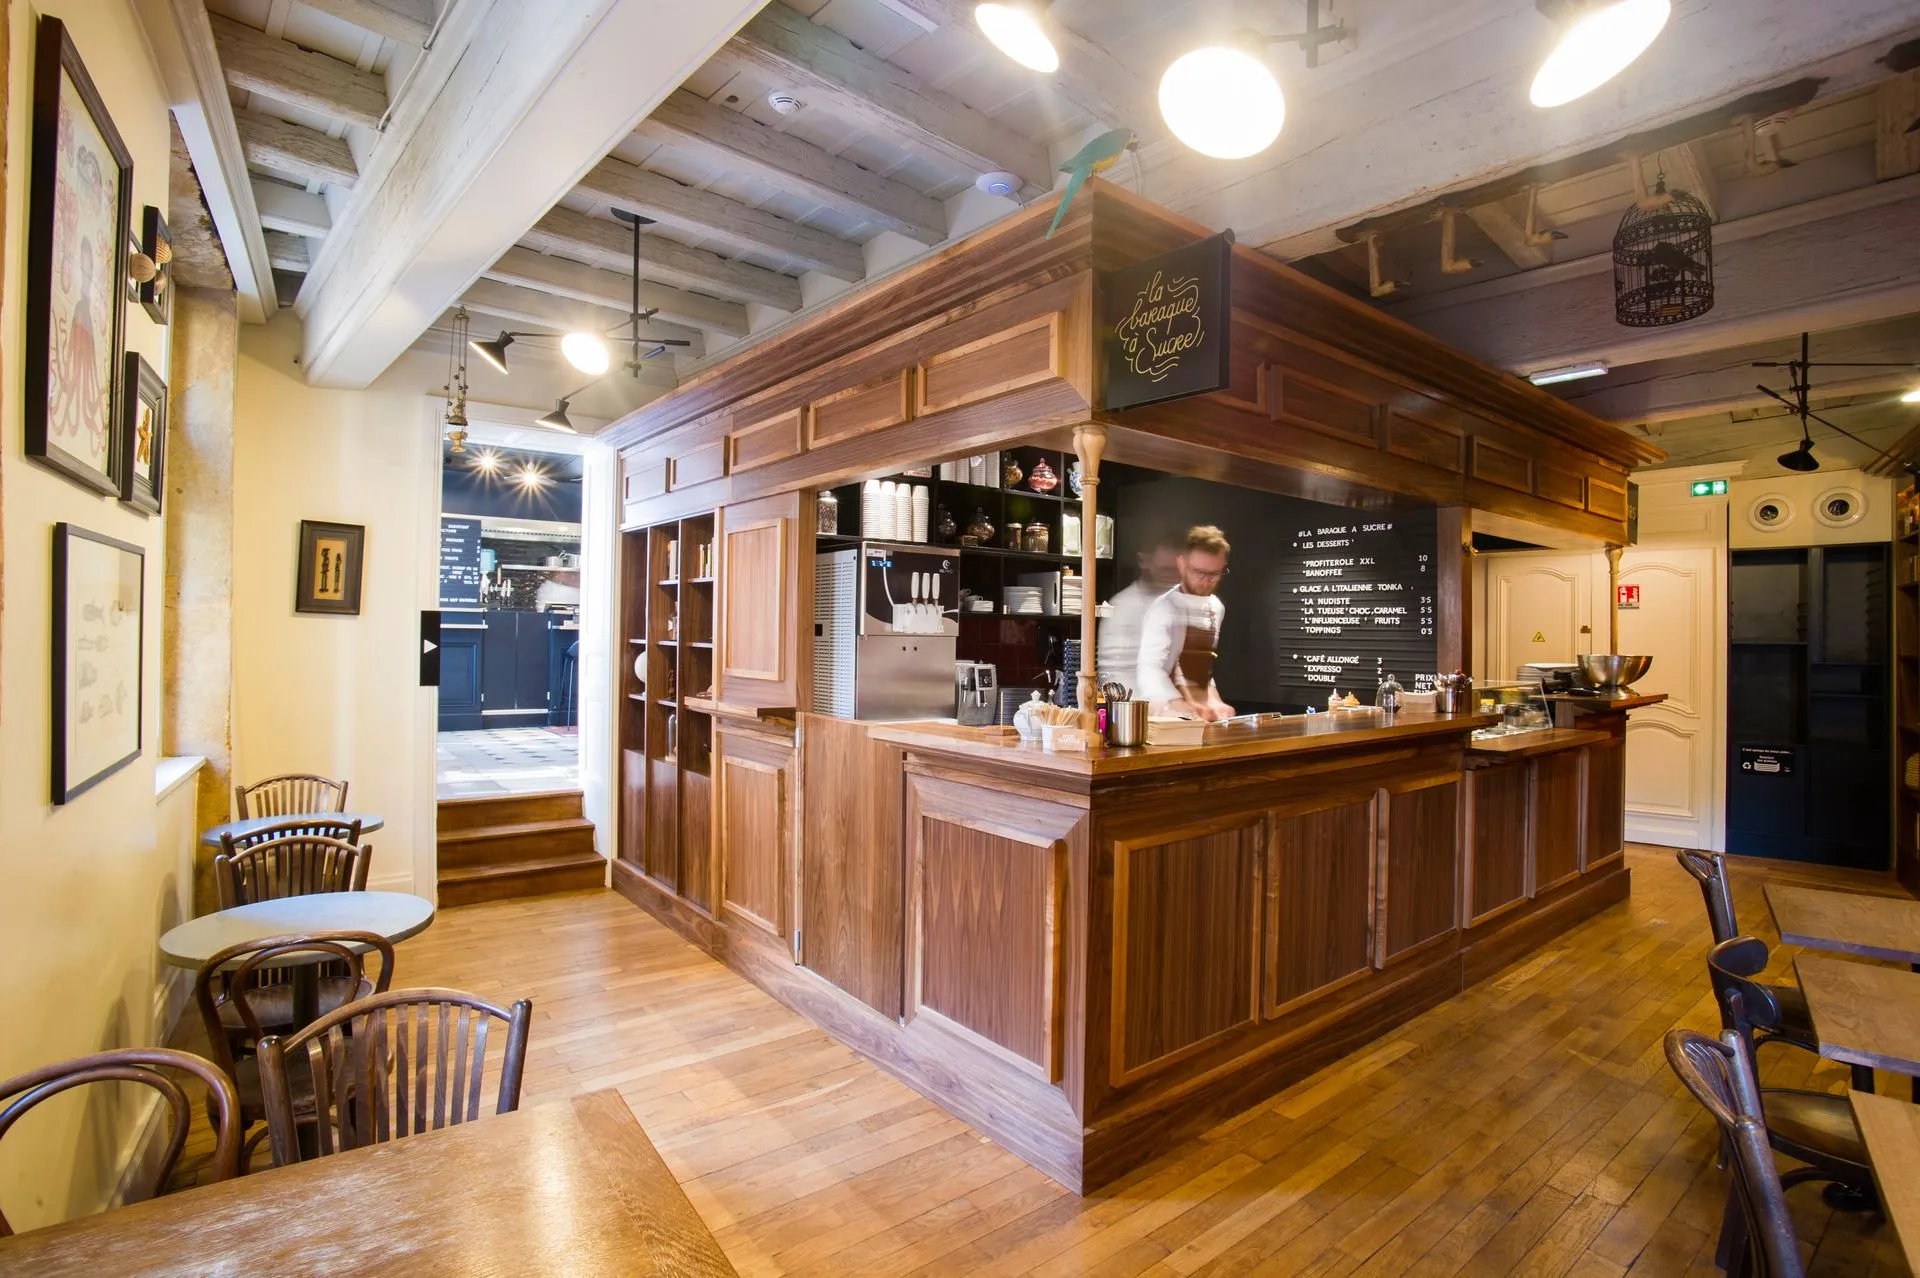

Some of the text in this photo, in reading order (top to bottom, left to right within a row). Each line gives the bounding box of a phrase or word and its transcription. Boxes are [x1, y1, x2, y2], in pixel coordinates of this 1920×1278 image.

[1149, 271, 1163, 302] la
[1317, 526, 1347, 535] BARAQUE
[1327, 656, 1360, 664] ALLONGÉ
[1416, 674, 1434, 682] PRIX
[1416, 682, 1432, 690] NET
